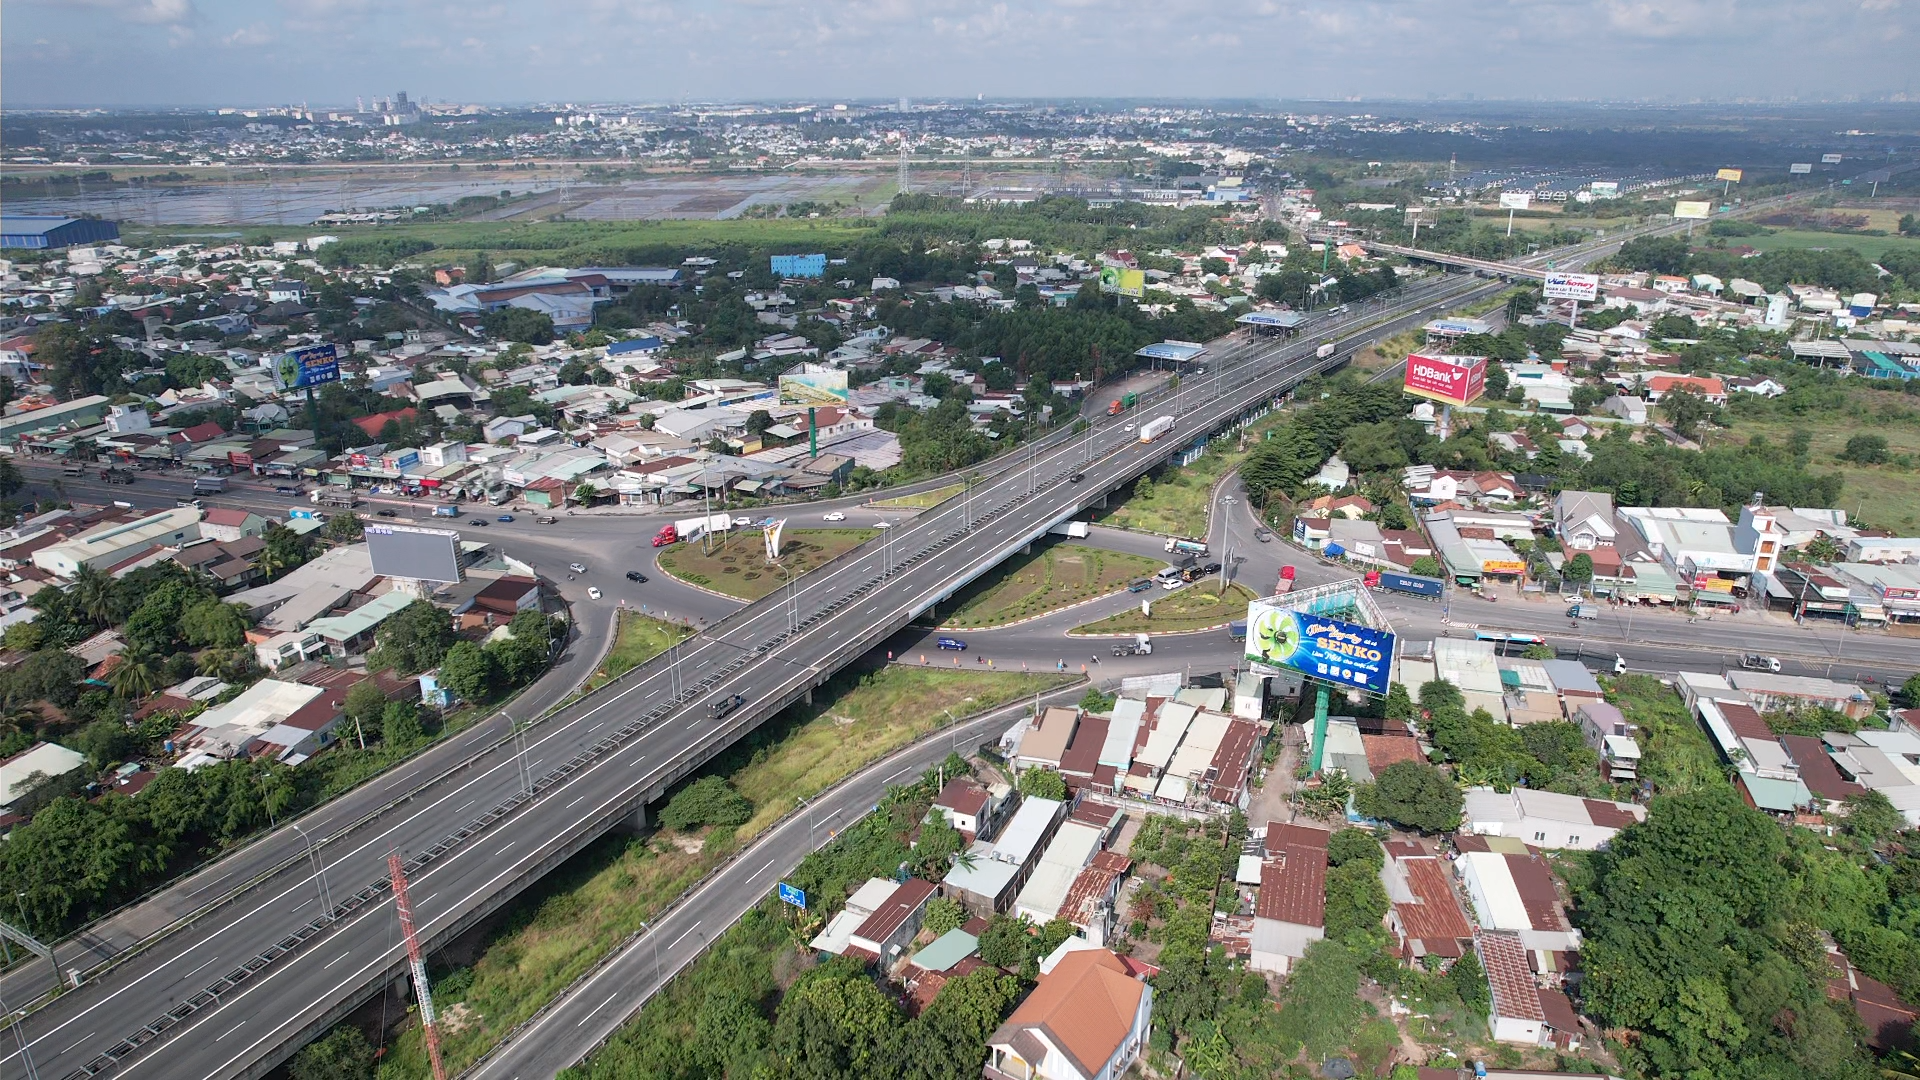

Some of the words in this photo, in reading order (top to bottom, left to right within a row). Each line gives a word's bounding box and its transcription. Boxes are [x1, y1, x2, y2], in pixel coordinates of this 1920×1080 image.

[304, 355, 335, 368] SENKO
[1413, 364, 1452, 384] HDBank
[1316, 637, 1382, 662] SENKO
